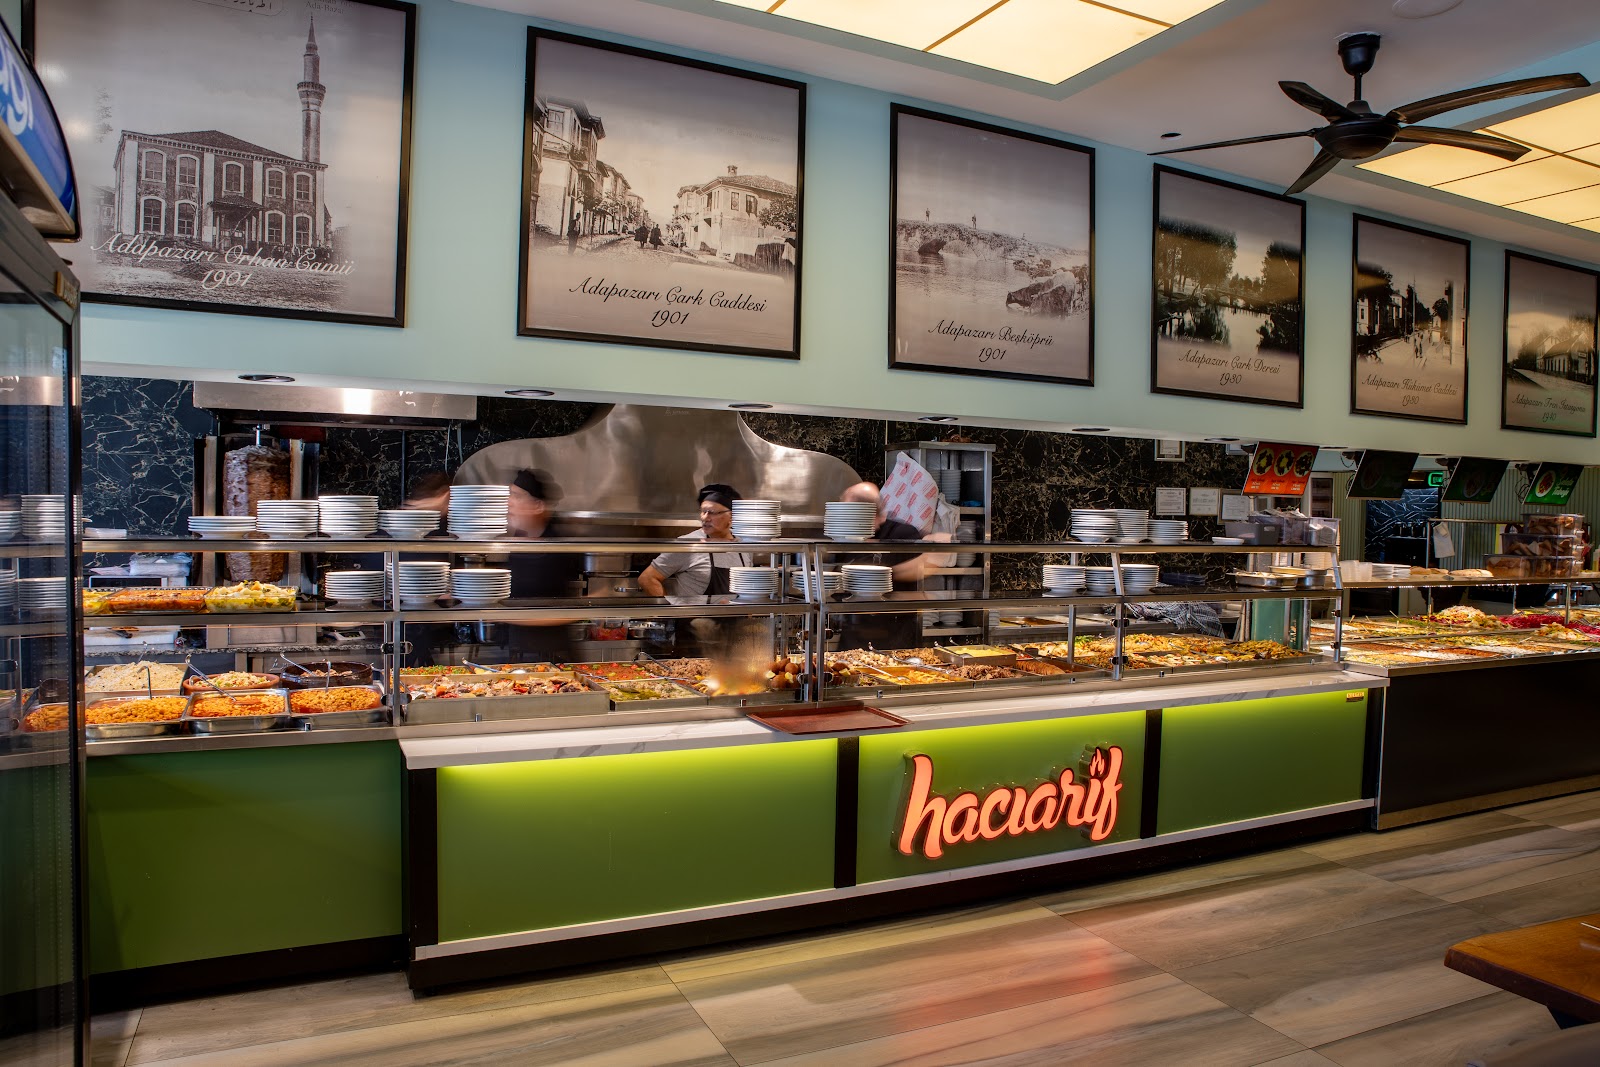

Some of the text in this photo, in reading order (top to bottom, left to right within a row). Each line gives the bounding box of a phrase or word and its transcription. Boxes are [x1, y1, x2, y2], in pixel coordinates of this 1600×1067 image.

[90, 232, 218, 263] Adapazarı
[223, 244, 293, 269] Orhan
[200, 269, 253, 290] 1901
[568, 276, 768, 312] Adapazarı Çark Caddesi
[650, 309, 690, 328] 1901
[927, 319, 1055, 350] Adapazarı Beşköprü
[978, 346, 1007, 363] 1901
[1178, 349, 1230, 369] Adapazarı
[1219, 372, 1243, 386] 1930
